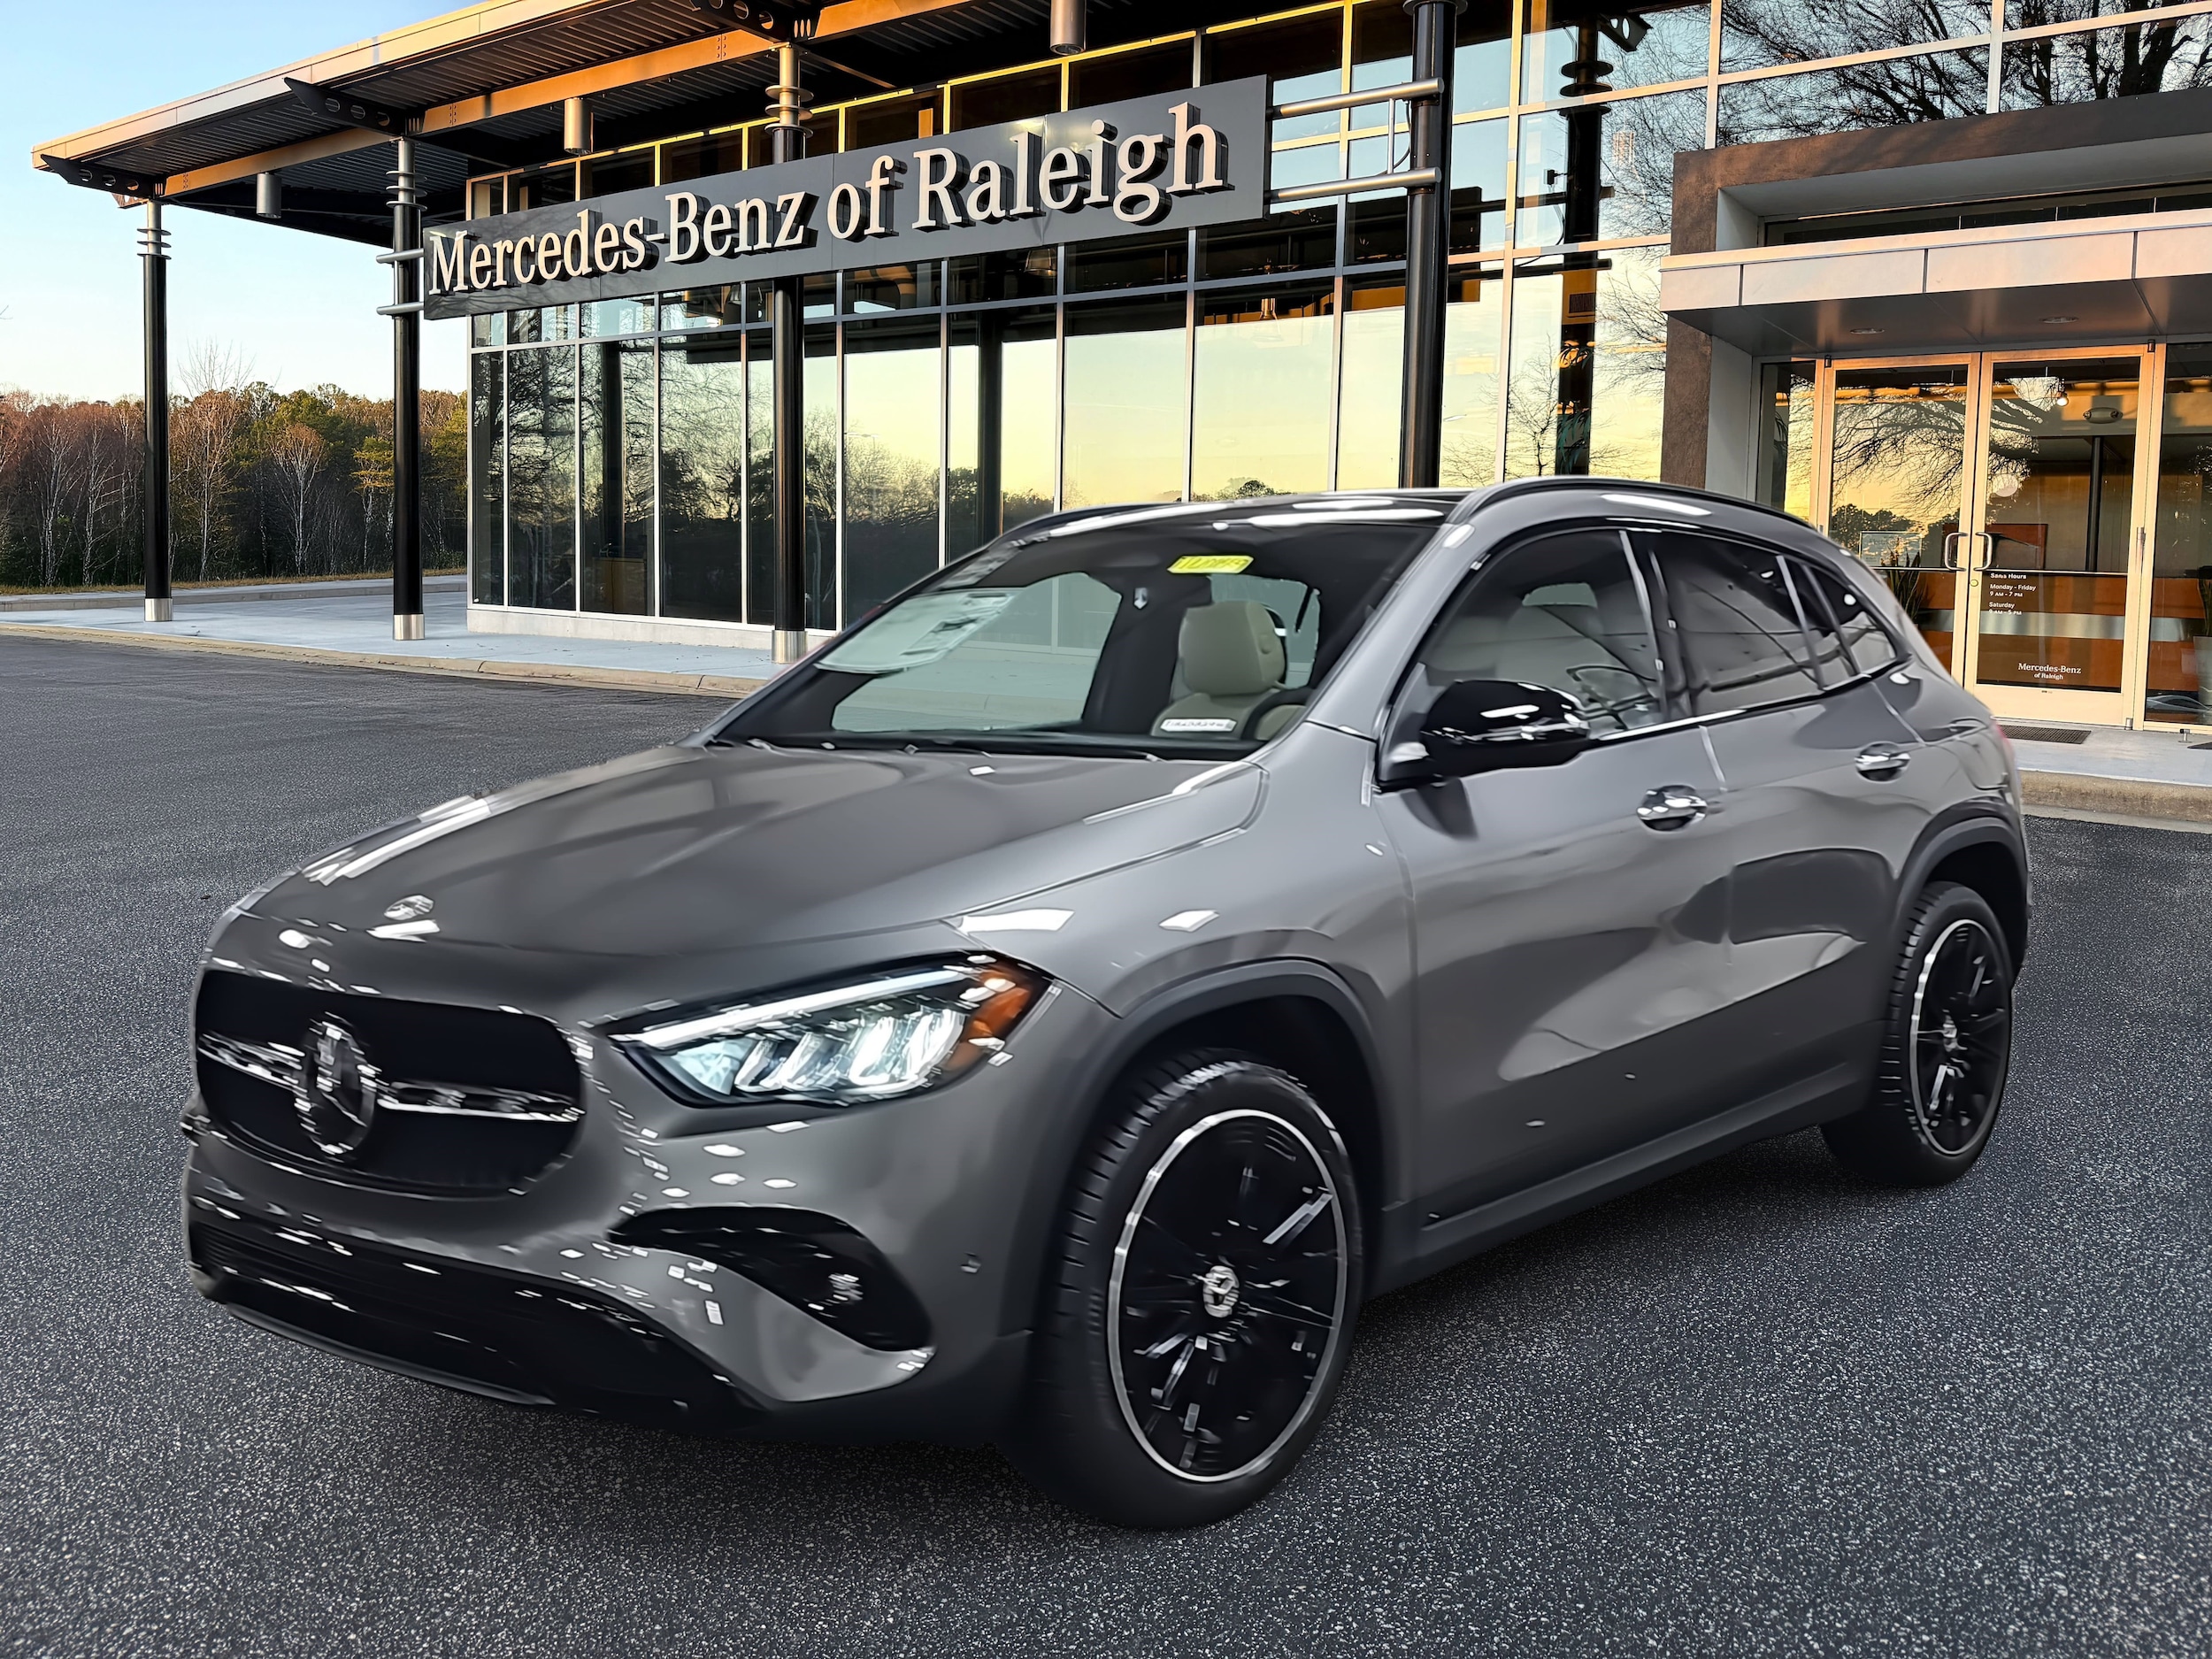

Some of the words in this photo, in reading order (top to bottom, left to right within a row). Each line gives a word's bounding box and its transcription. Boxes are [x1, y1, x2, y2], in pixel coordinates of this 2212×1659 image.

[428, 191, 812, 296] Mercedes-Benz
[826, 155, 896, 241] of
[911, 102, 1225, 223] Raleigh
[2018, 663, 2081, 673] Mercedes-Benz
